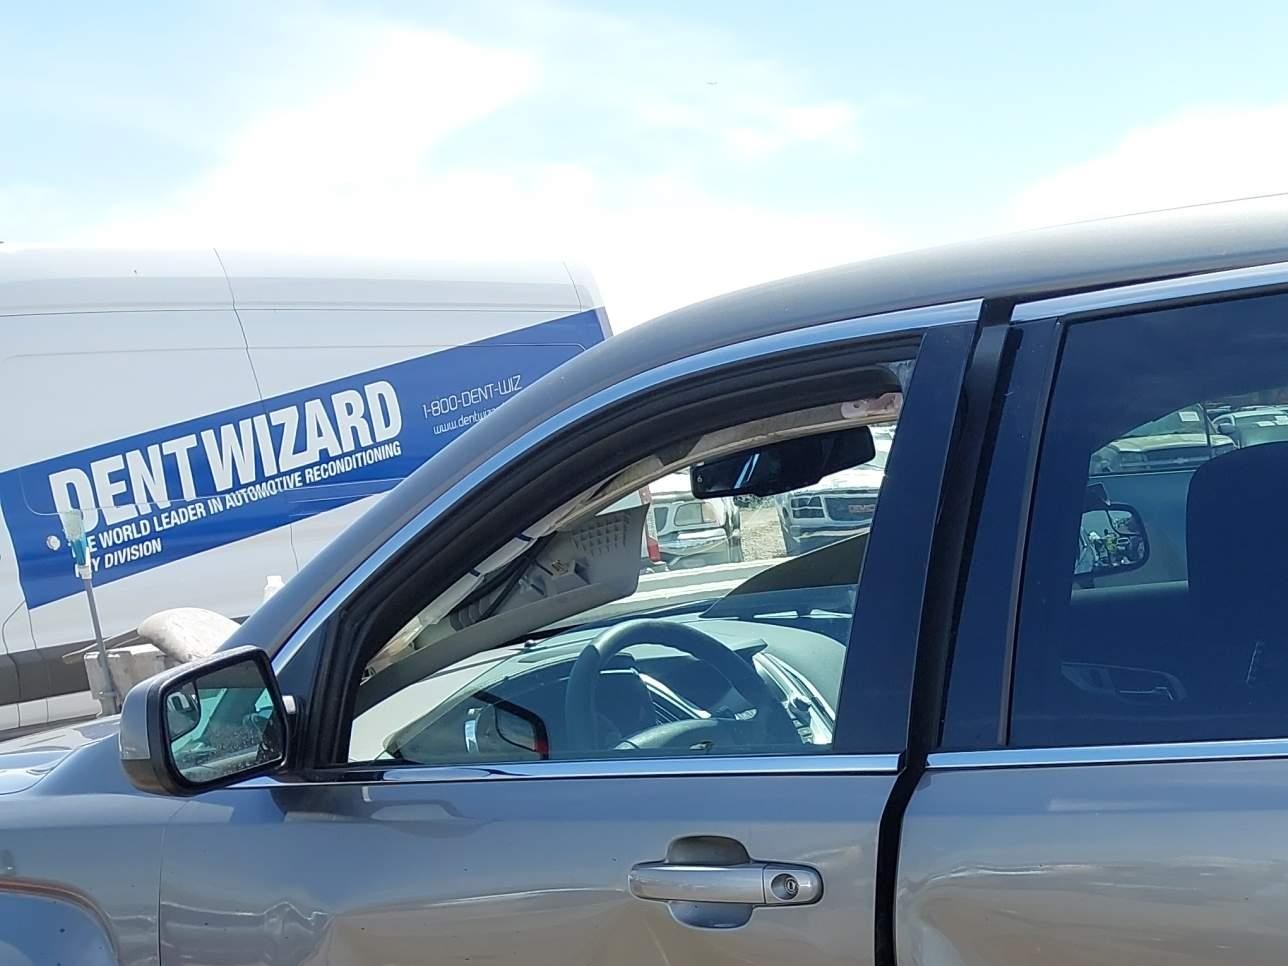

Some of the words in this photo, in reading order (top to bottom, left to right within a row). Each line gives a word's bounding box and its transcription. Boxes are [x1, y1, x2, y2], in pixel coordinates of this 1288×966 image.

[422, 375, 522, 419] 1-800-DENT-WIZ
[99, 519, 151, 549] WORLD
[153, 502, 206, 532] LEADER
[209, 496, 223, 515] IN
[226, 471, 303, 510] AUTOMOTIVE
[305, 441, 402, 483] RECONDITIONING
[104, 538, 162, 569] DIVISION
